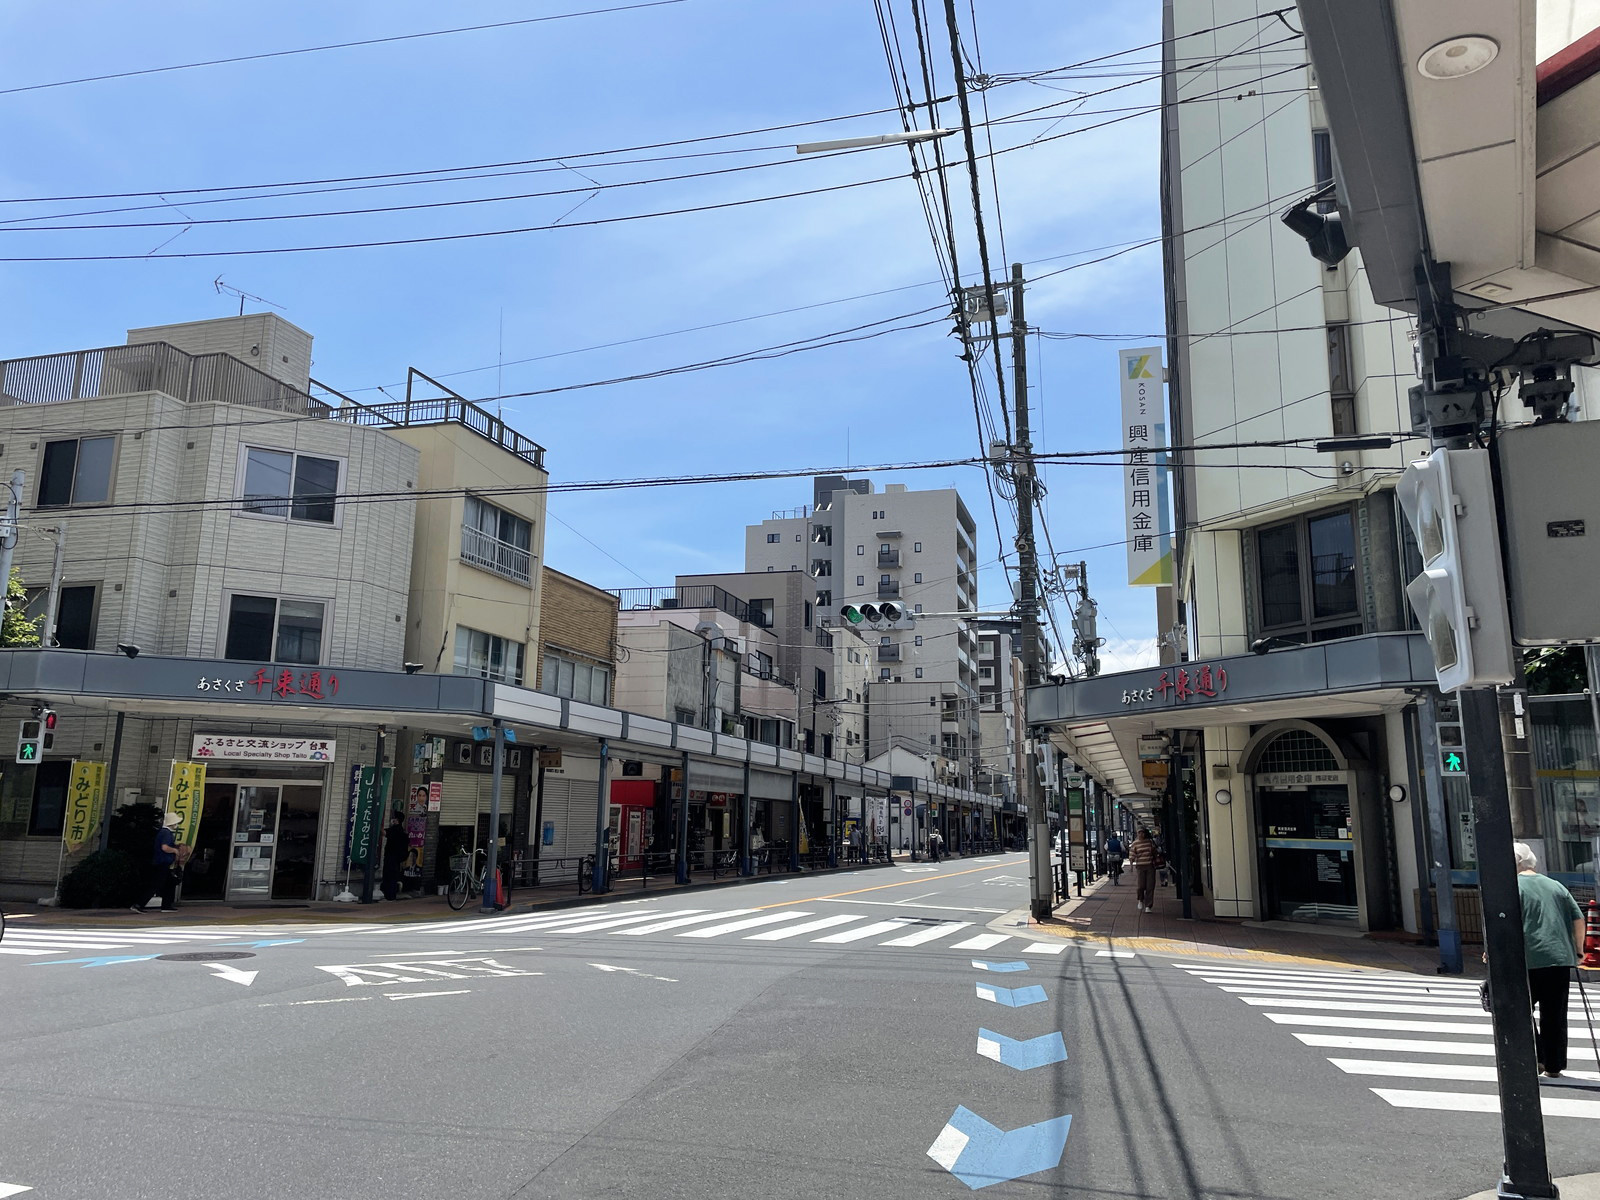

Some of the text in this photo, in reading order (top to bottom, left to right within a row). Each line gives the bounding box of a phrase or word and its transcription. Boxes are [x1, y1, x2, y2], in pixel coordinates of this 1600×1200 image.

[1138, 382, 1147, 415] KOSAN
[1128, 424, 1154, 553] 興産信用金庫
[197, 676, 245, 692] あさくさ
[1121, 687, 1154, 705] あさくさ
[203, 737, 329, 751] ふるさと交流ショップ 台東
[243, 750, 272, 759] Specialty
[274, 751, 291, 759] Shop
[70, 777, 90, 841] みどり市
